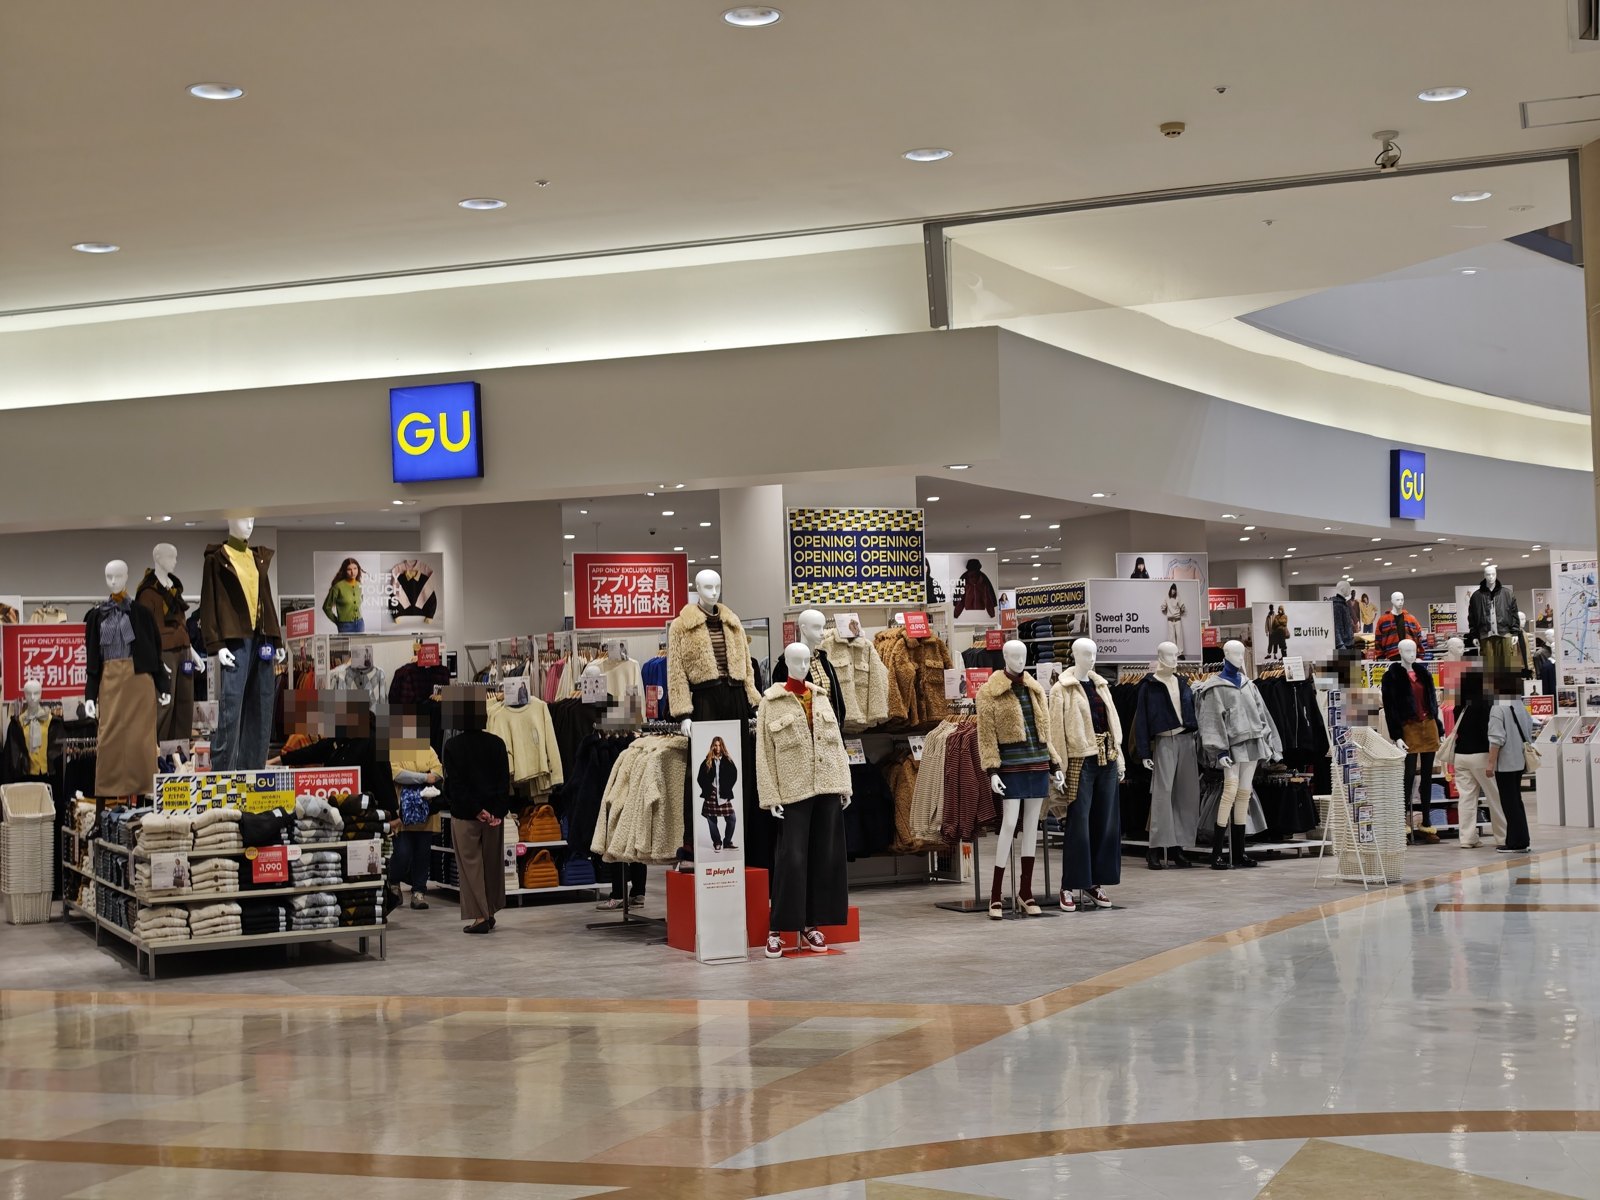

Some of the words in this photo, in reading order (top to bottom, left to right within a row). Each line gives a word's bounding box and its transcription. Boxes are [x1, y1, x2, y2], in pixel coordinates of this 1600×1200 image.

[397, 411, 471, 455] GU
[1400, 469, 1424, 501] GU
[793, 535, 857, 547] OPENING!
[860, 535, 921, 547] OPENING!
[794, 551, 857, 563] OPENING!
[861, 551, 922, 562] OPENING!
[794, 565, 857, 577] OPENING!
[861, 565, 922, 577] OPENING!
[592, 574, 670, 593] アプリ会員
[593, 593, 671, 615] 特別価格
[1017, 594, 1049, 606] OPENING!
[1050, 590, 1084, 603] OPENING!
[1095, 612, 1123, 622] Sweat
[1126, 613, 1139, 622] 3D
[1095, 624, 1122, 633] Barrel
[1125, 624, 1150, 633] Pants
[1303, 627, 1329, 639] utility
[257, 778, 275, 788] GU
[713, 866, 735, 877] playful
